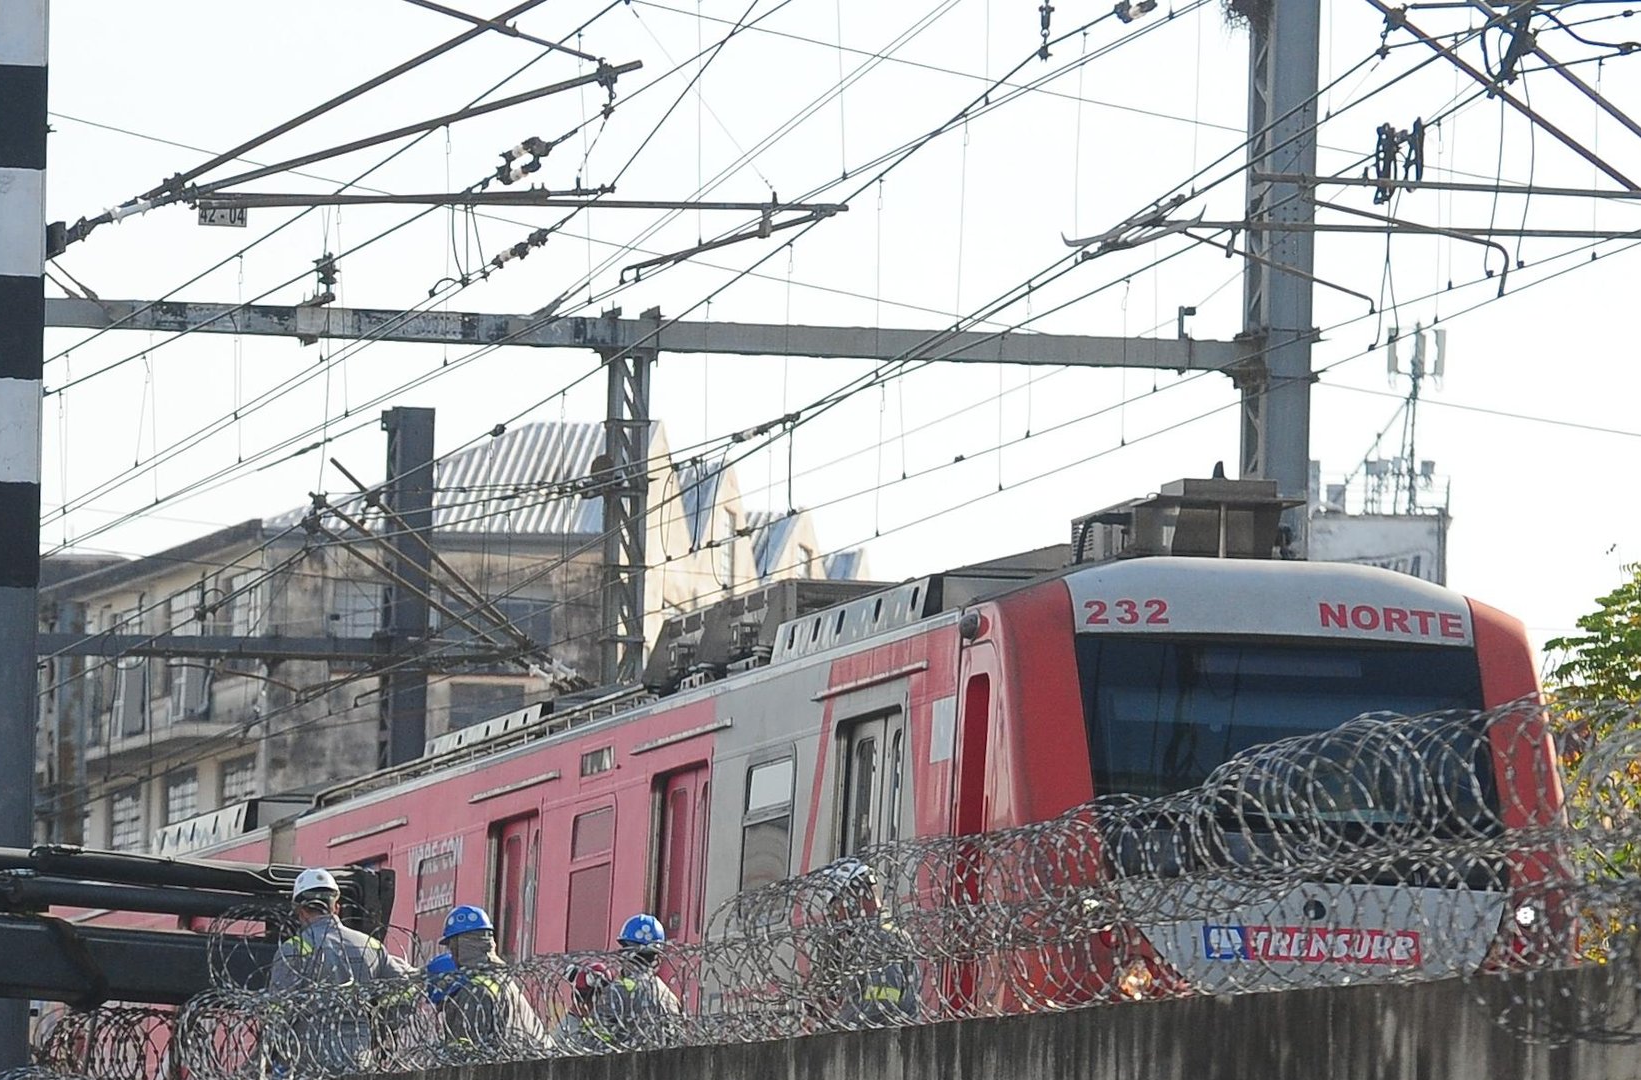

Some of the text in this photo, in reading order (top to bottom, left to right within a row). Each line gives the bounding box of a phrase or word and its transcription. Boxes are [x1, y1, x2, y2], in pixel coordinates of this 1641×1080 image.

[1084, 598, 1170, 625] 232
[1318, 602, 1465, 639] NORTE
[1255, 931, 1415, 961] TRENSURB
